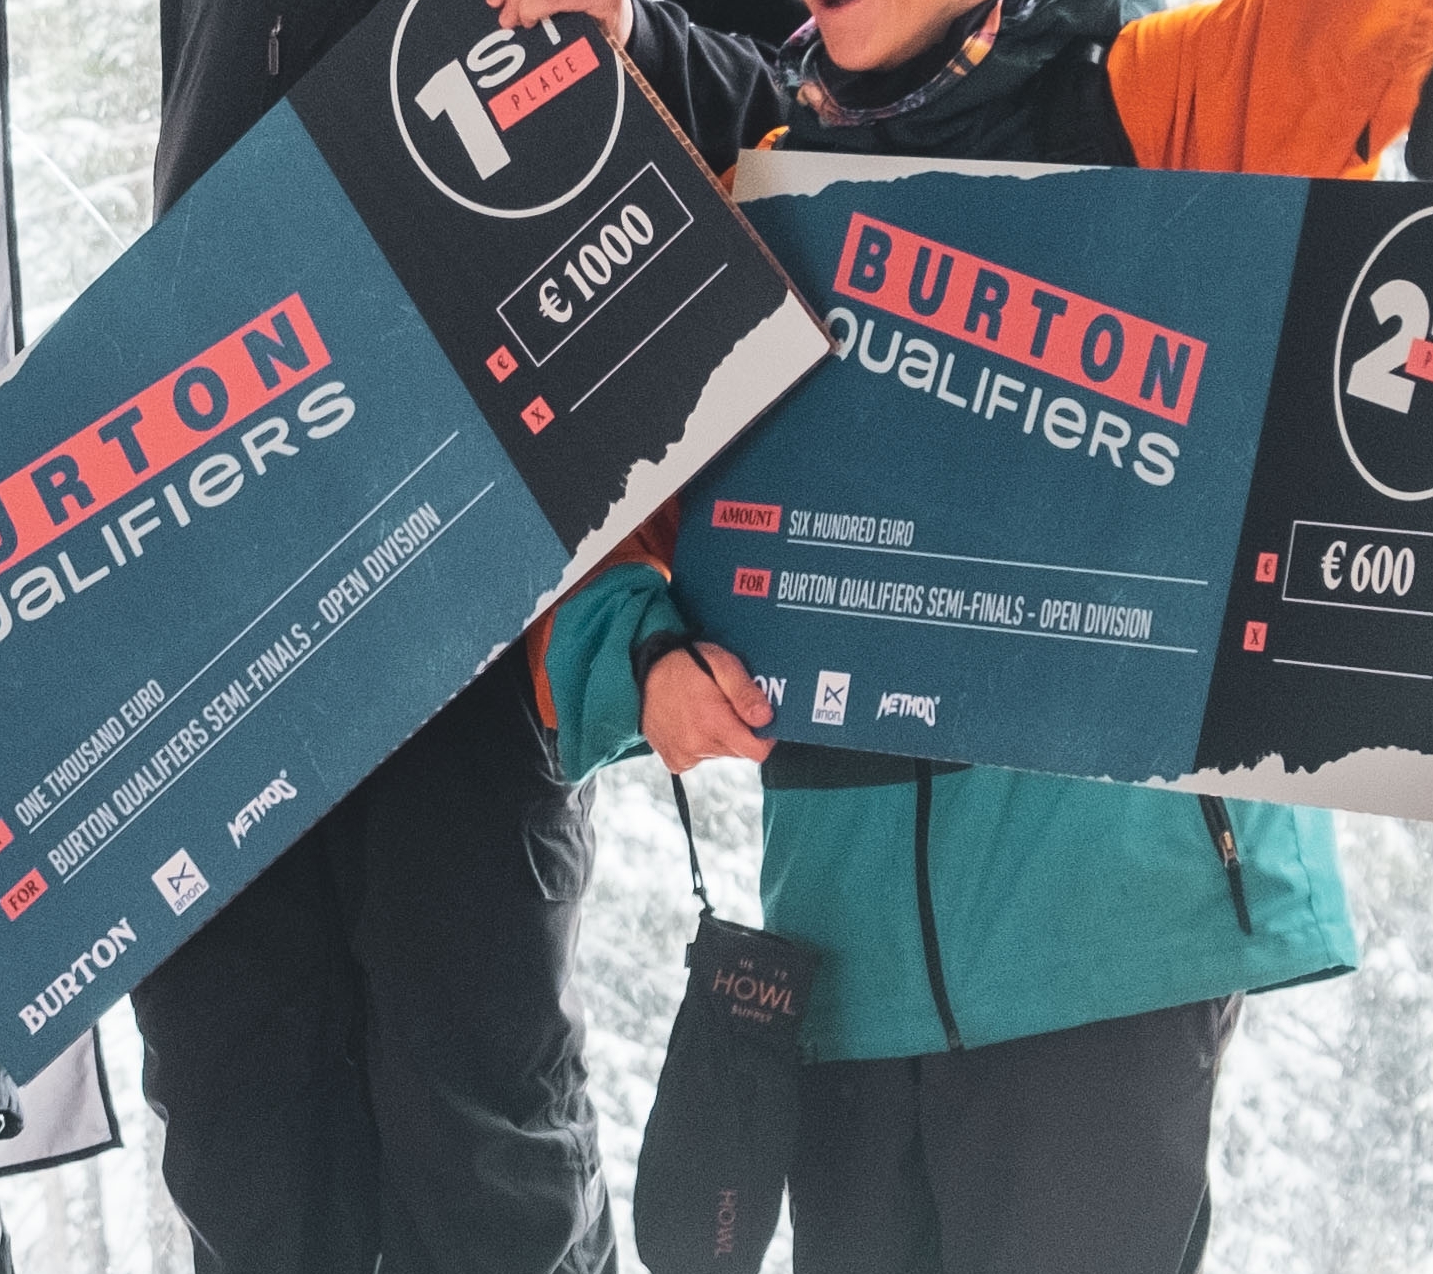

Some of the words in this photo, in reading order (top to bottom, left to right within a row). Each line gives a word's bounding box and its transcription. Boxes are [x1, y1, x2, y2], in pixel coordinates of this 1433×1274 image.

[511, 55, 579, 111] PLACE
[848, 224, 1192, 410] BURTON
[530, 408, 546, 425] X
[720, 508, 775, 528] AMOUNT
[788, 510, 810, 538] SIX
[813, 513, 875, 544] HUNDRED
[878, 518, 915, 548] EURO
[739, 574, 765, 592] FOR
[778, 571, 836, 605] BURTON
[839, 579, 924, 616] QUALIFIERS
[927, 587, 1024, 626] SEMI-FINALS
[1039, 597, 1082, 632] OPEN
[1084, 603, 1154, 640] DIVISION
[1250, 627, 1262, 647] X
[47, 802, 119, 877] BURTON
[113, 719, 209, 816] QUALIFIERS
[202, 622, 313, 733] SEMI-FINALS
[318, 568, 370, 625] OPEN
[362, 502, 442, 583] DIVISION
[876, 691, 936, 726] METHOD
[14, 793, 51, 827] ONE
[45, 717, 126, 797] THOUSAND
[120, 679, 166, 731] EURO
[227, 774, 297, 849] METHOD
[8, 879, 41, 913] FOR
[174, 881, 205, 912] anon
[18, 917, 138, 1036] BURTON
[712, 968, 796, 1016] HOWL
[715, 1189, 736, 1256] HOWL
